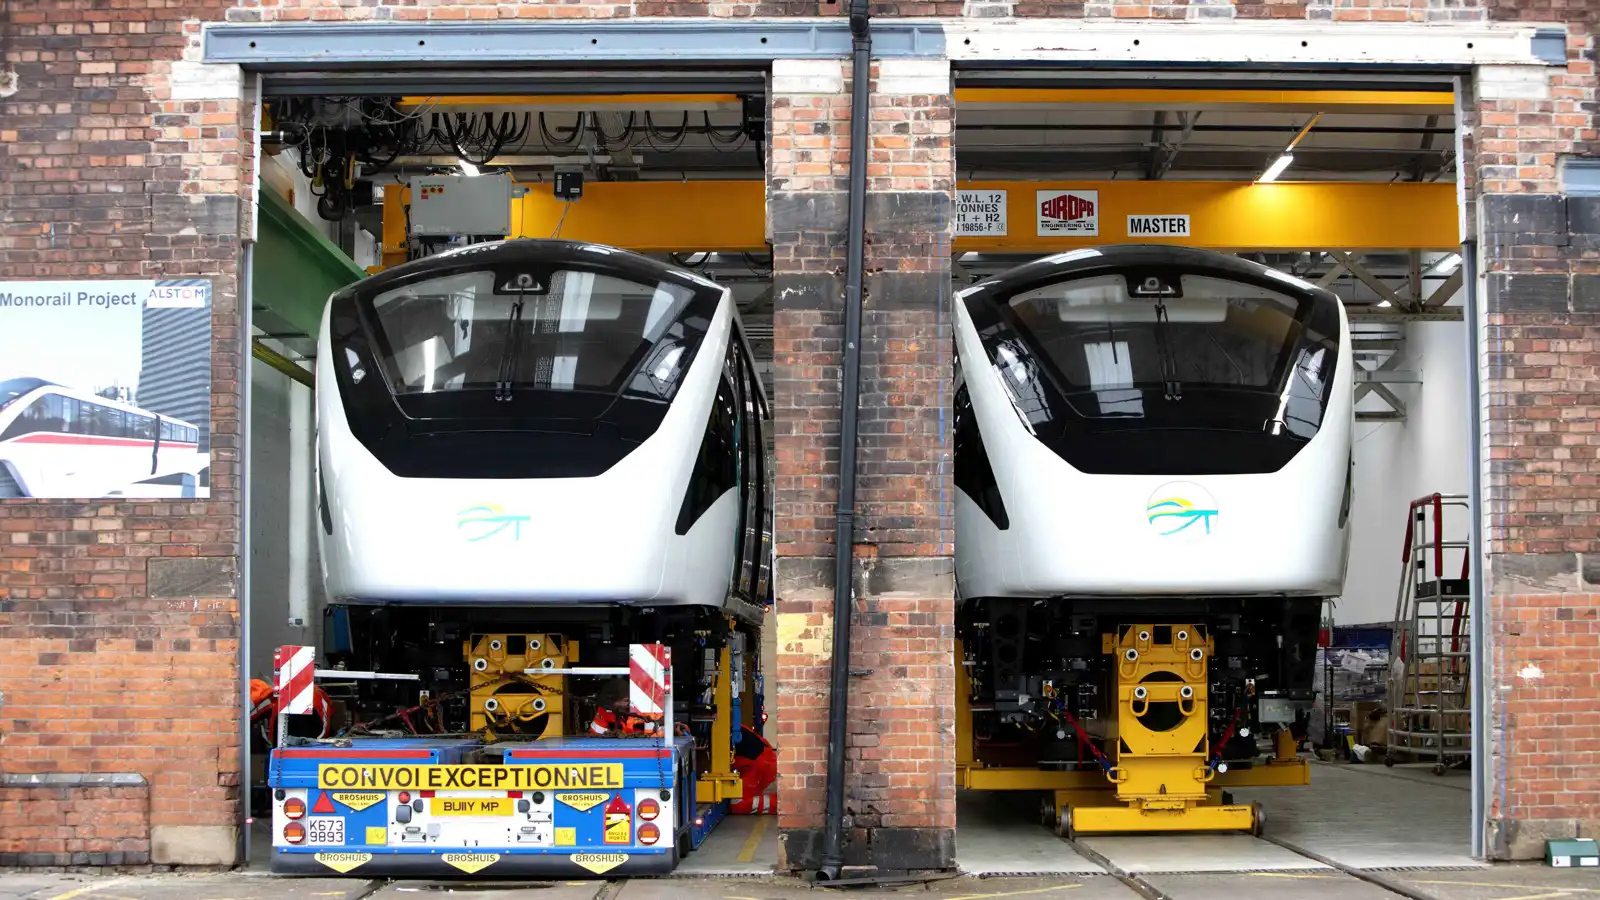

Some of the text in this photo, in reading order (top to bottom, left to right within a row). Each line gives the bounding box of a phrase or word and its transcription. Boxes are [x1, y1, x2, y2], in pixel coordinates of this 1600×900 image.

[956, 194, 1002, 203] .W.L. 12
[1041, 194, 1094, 220] EUROPA
[985, 213, 1000, 222] H2
[961, 223, 992, 231] 19856-F
[1130, 218, 1186, 233] MASTER
[148, 288, 205, 299] ALSTOM
[0, 291, 137, 309] Monorail Project
[322, 766, 619, 787] CONVOI EXCEPTIONNEL
[481, 802, 499, 811] MP
[309, 820, 343, 831] K673
[310, 831, 343, 842] 9893
[447, 854, 496, 862] BROSHUIS
[575, 854, 624, 862] BROSHUIS
